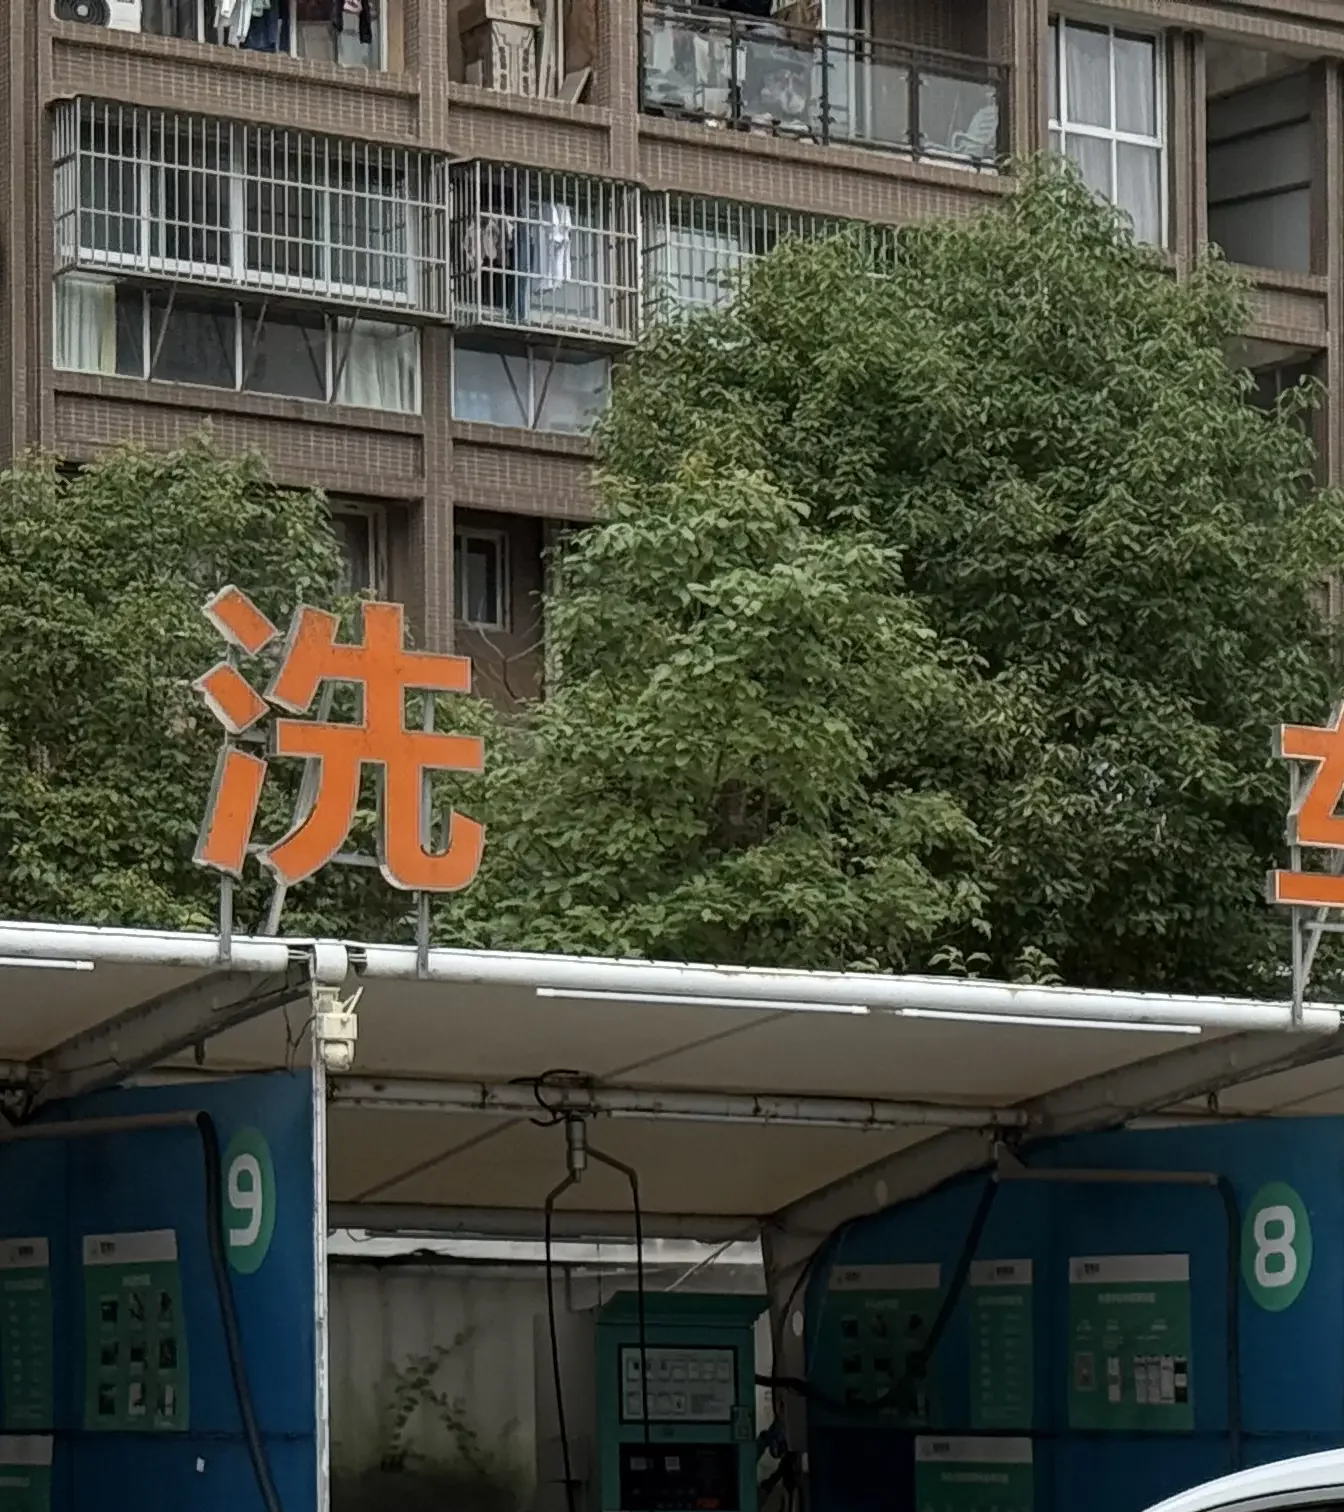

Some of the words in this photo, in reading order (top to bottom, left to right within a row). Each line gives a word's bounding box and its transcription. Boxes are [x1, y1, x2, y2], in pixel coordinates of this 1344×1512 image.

[193, 584, 486, 893] 洗
[227, 1152, 263, 1247] 9
[1253, 1204, 1298, 1288] 8
